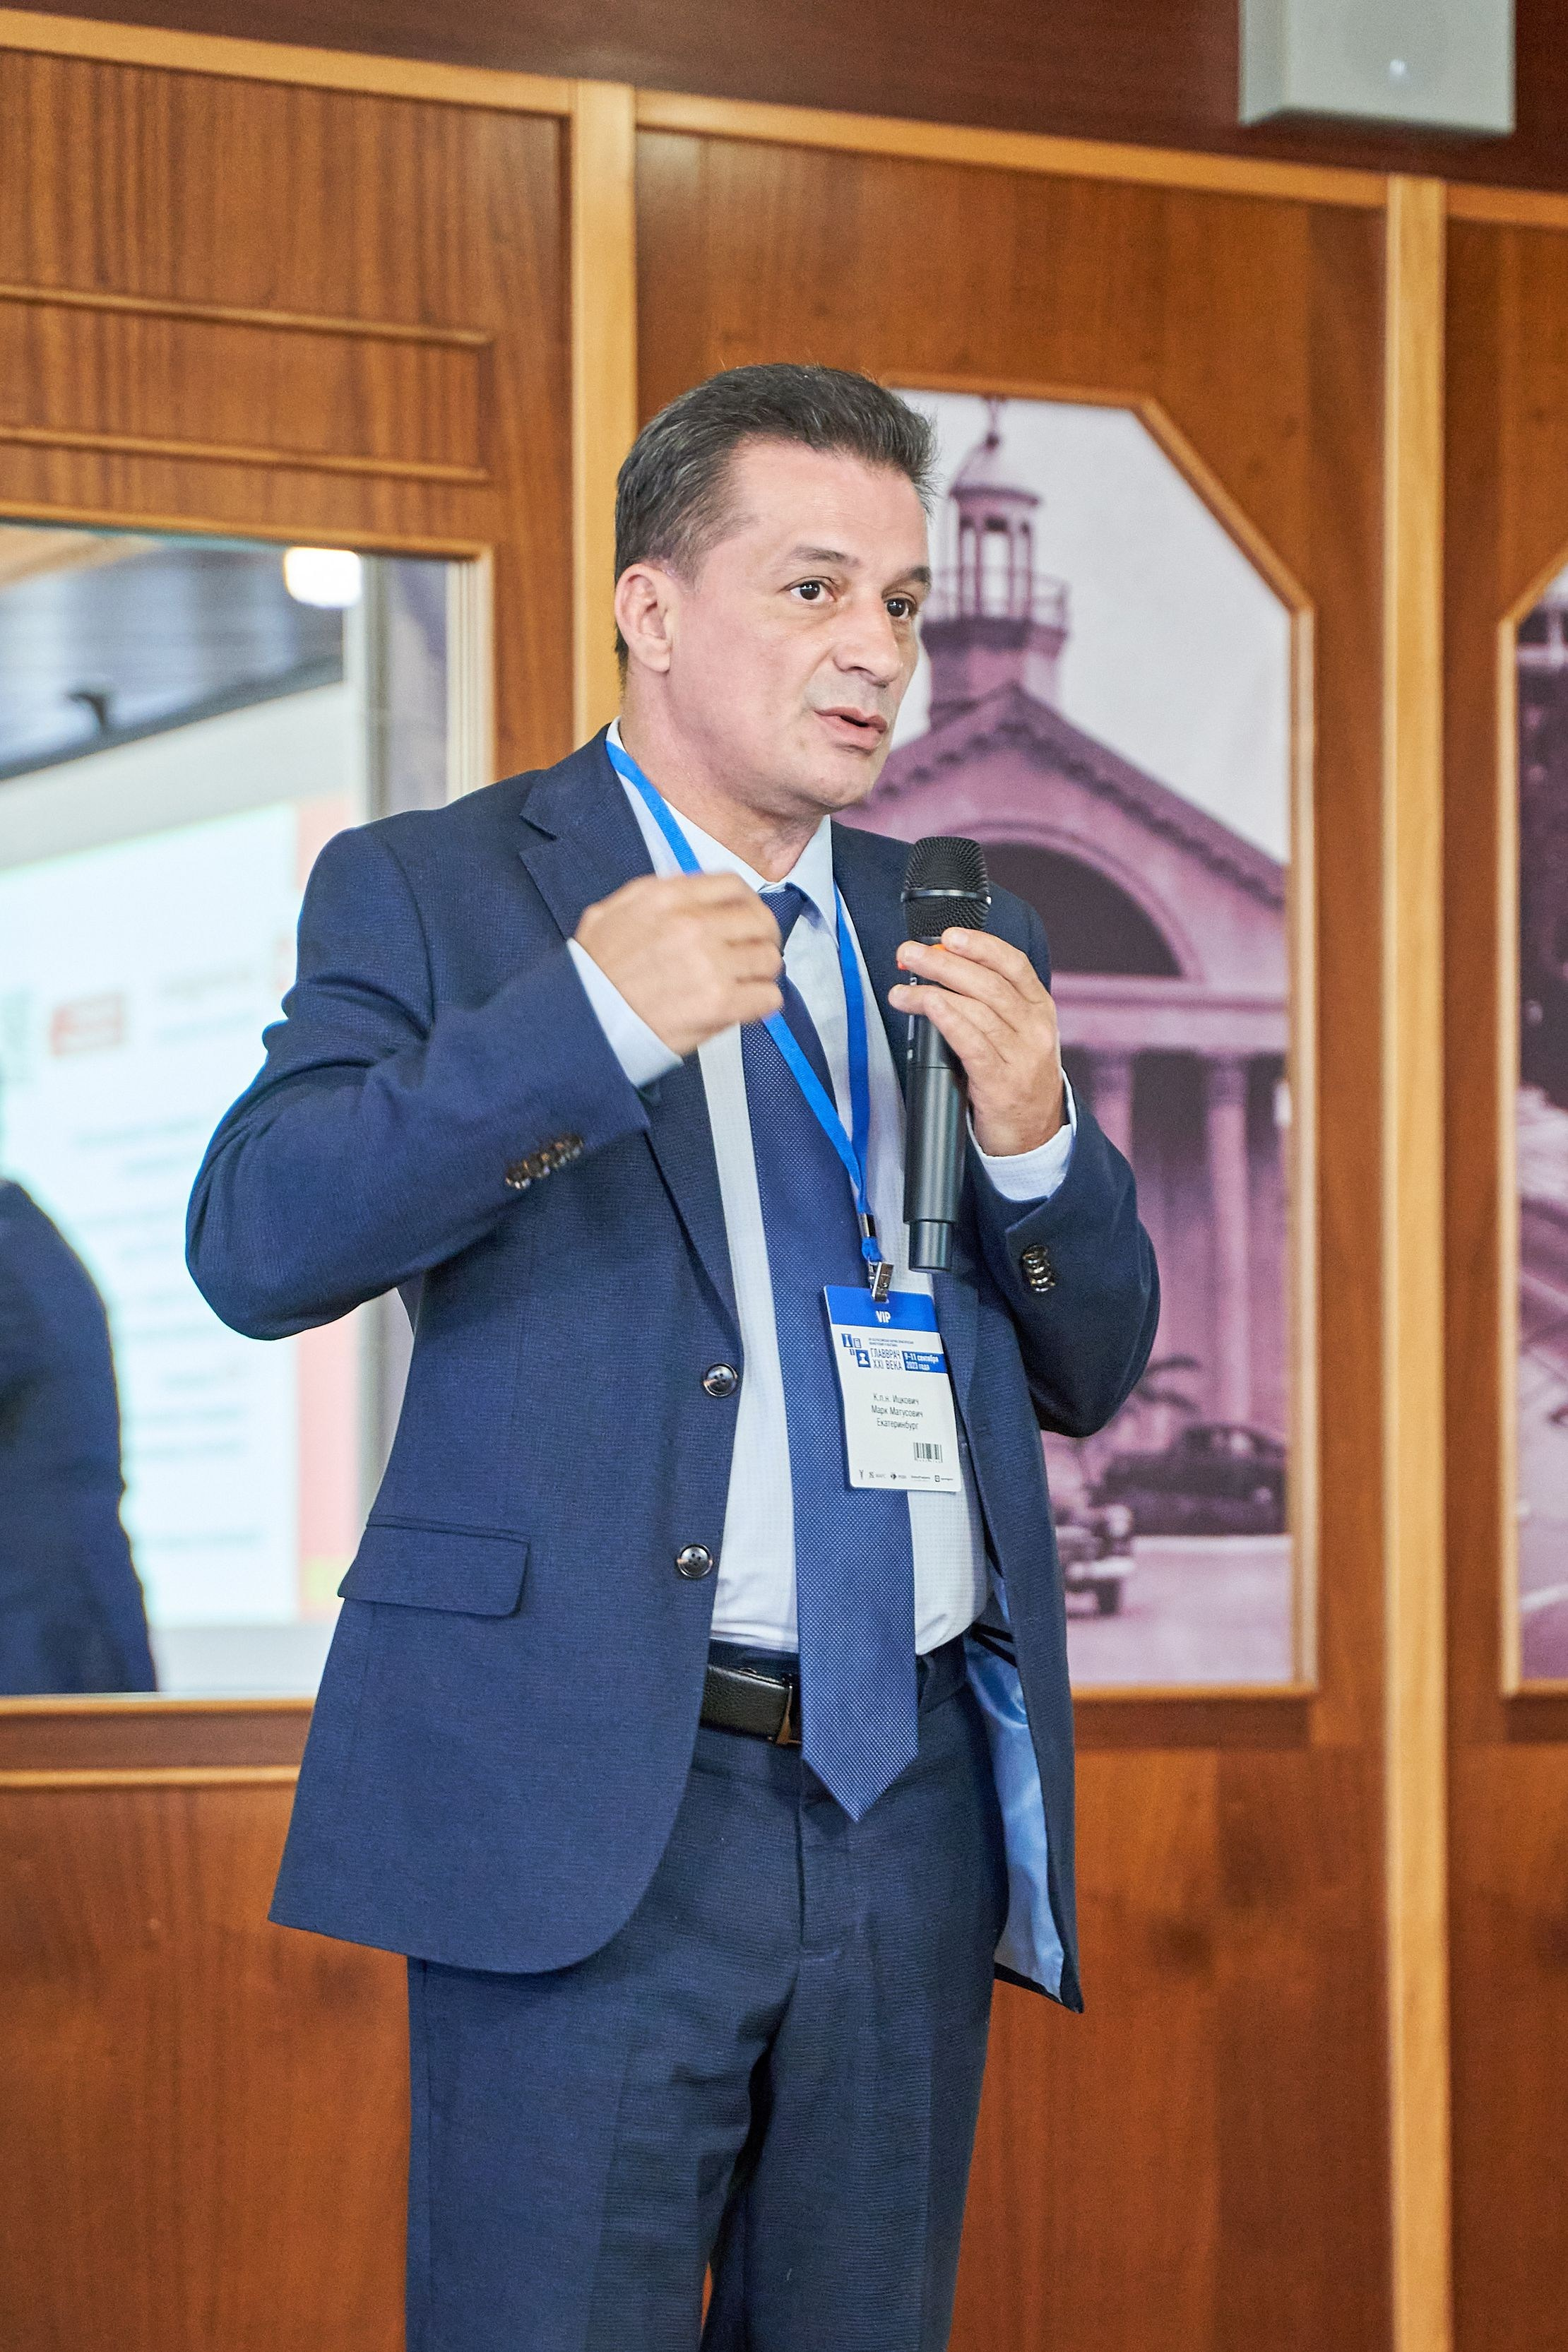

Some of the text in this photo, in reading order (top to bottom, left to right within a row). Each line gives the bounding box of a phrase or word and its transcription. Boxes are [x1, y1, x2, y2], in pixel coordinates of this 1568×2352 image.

[876, 1311, 891, 1323] VIP
[870, 1348, 901, 1360] ГЛАВВРАЧ
[873, 1359, 903, 1370] XXI ВЕКА
[871, 1405, 923, 1418] Марк Матусович
[877, 1418, 919, 1430] Екатеринбург
